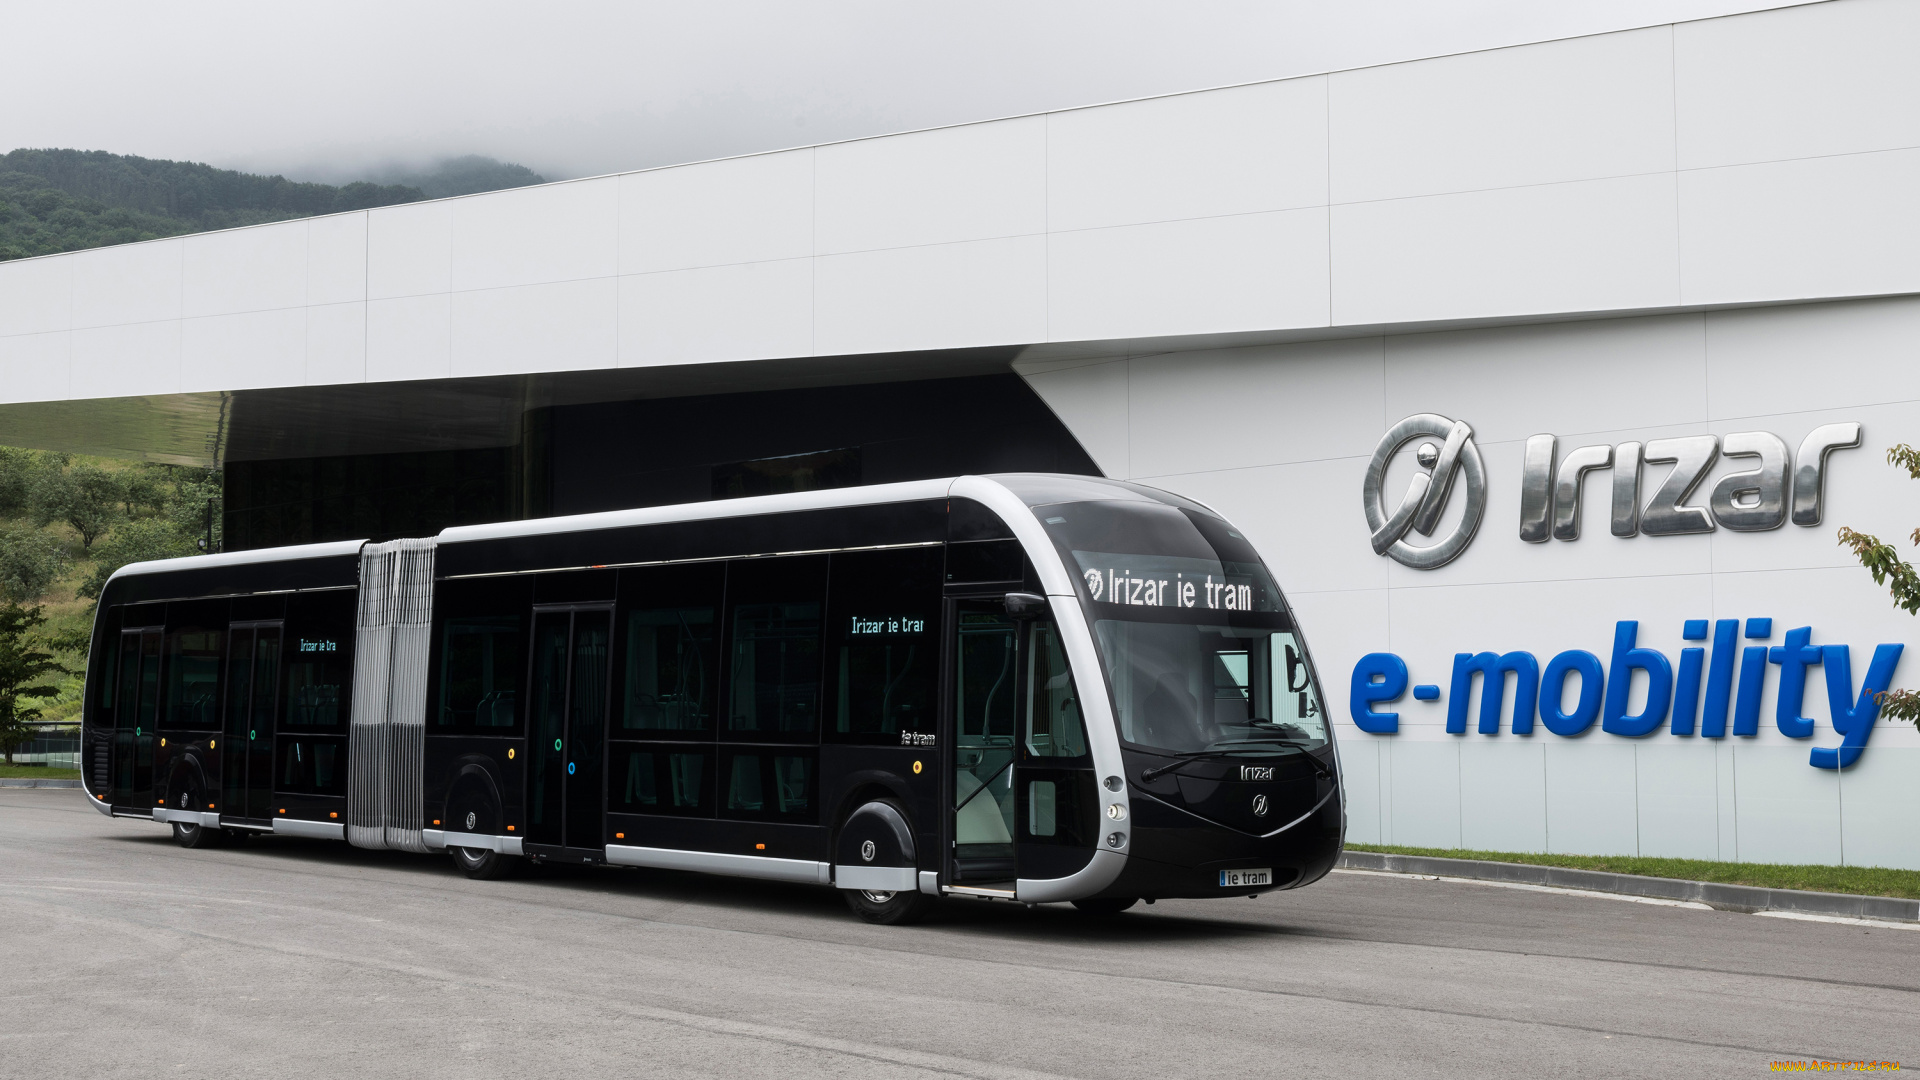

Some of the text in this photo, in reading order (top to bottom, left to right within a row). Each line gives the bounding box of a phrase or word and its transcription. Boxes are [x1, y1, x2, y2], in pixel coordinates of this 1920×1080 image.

[1519, 421, 1862, 544] Irizar
[1108, 568, 1252, 611] Irizar ie tram
[851, 616, 885, 634] Irizar
[888, 617, 899, 633] ie
[300, 638, 318, 652] Irizar
[1349, 617, 1905, 770] e-mobility
[901, 729, 936, 746] ie tram
[1240, 765, 1276, 781] Irizar
[1227, 871, 1268, 885] ie tram
